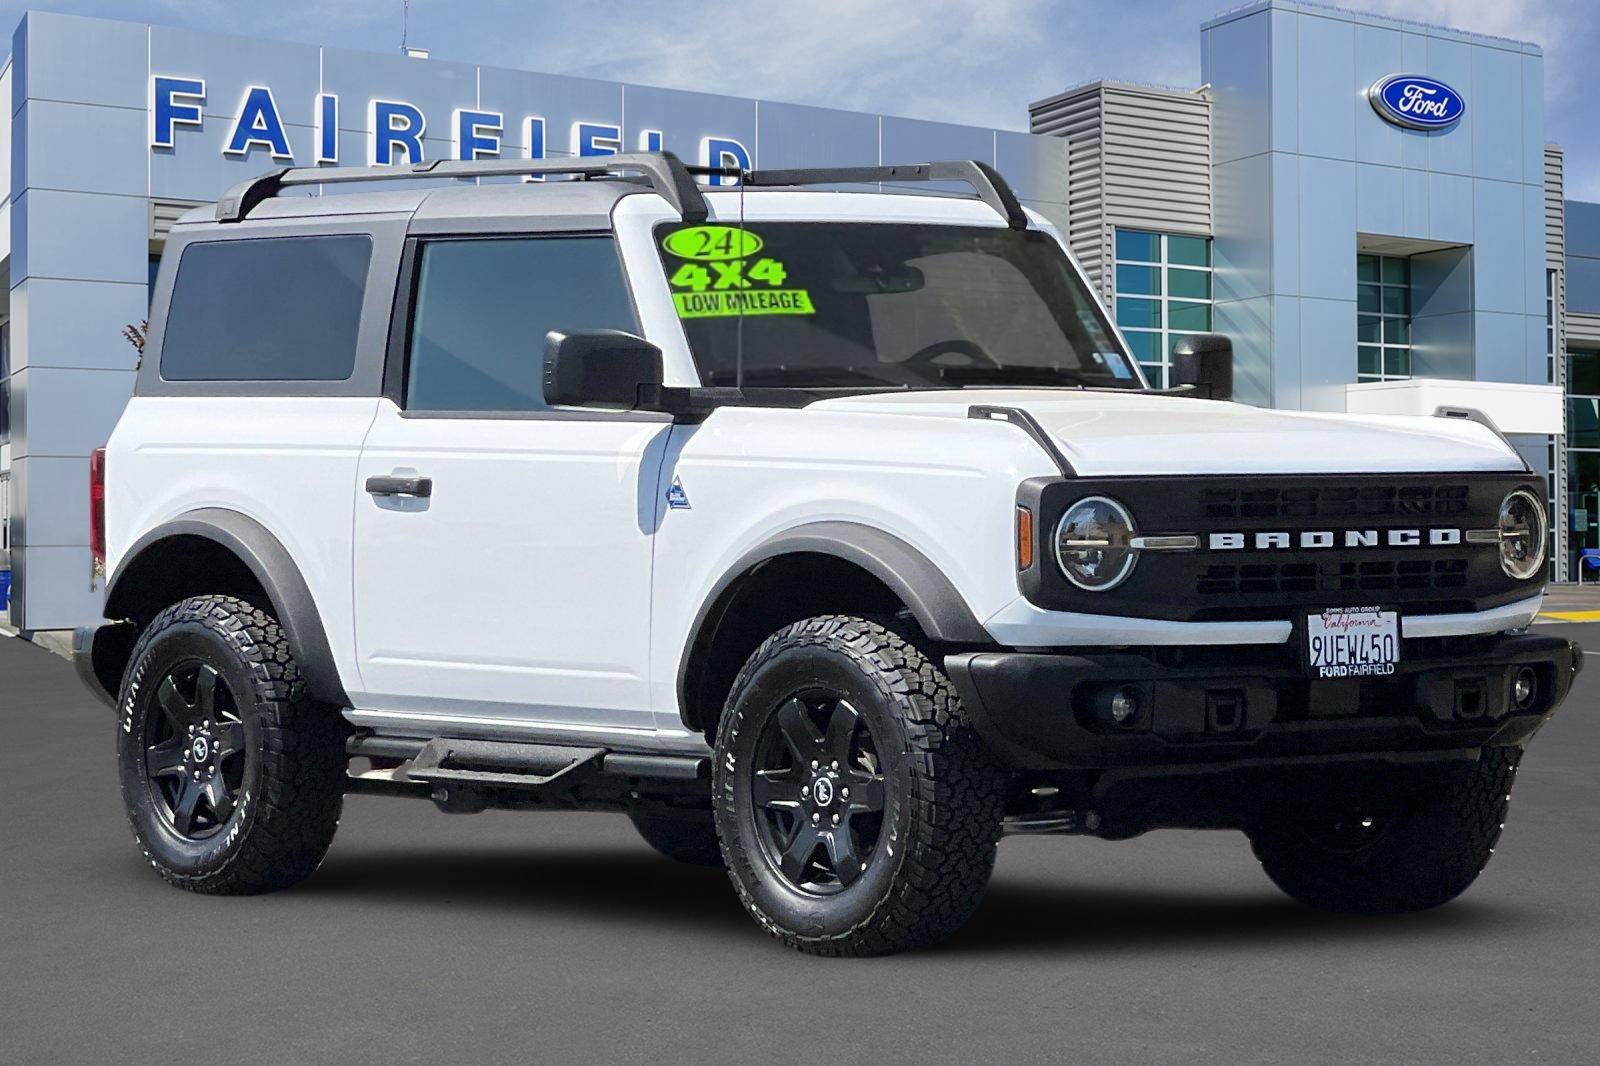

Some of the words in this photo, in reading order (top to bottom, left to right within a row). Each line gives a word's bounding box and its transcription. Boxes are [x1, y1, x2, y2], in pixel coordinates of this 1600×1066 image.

[1399, 84, 1449, 117] Ford
[694, 230, 733, 256] 24
[682, 295, 720, 312] LOW
[726, 293, 801, 310] MILEAGE
[1209, 529, 1460, 549] BRONCO
[1323, 613, 1382, 632] California
[1312, 634, 1394, 666] 9UEW450
[1320, 666, 1347, 677] FORD
[1348, 663, 1394, 676] FAIRFIELD
